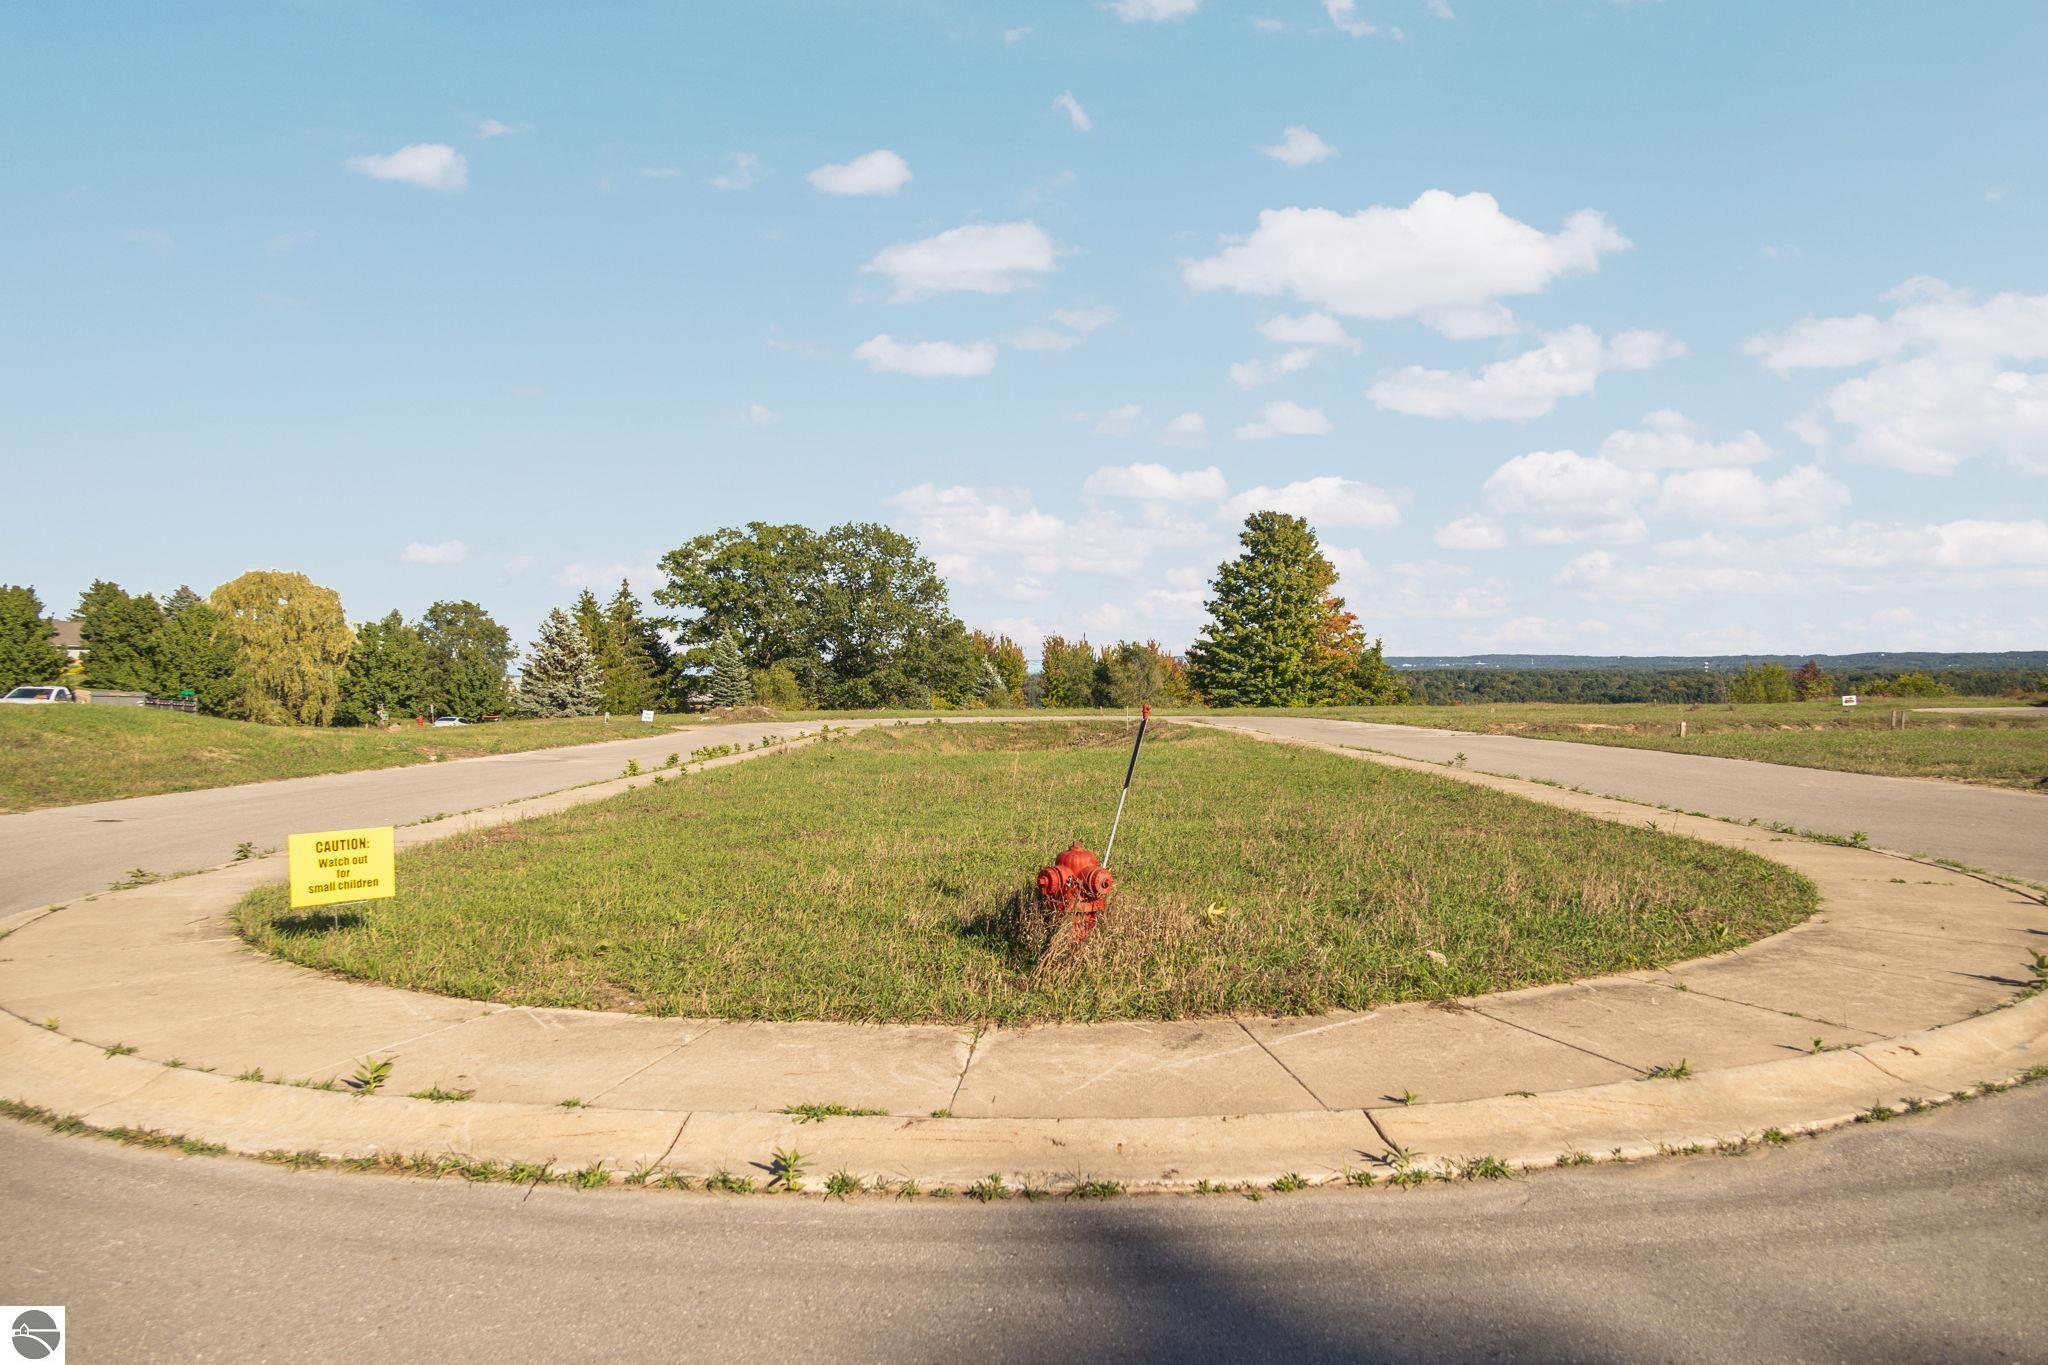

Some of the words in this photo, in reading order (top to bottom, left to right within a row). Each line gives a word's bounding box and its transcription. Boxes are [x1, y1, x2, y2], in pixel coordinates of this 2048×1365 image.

[316, 838, 369, 853] CAUTION:
[319, 857, 350, 868] Watch
[352, 855, 368, 865] out
[336, 869, 350, 878] for
[308, 882, 335, 893] small
[338, 879, 379, 890] children
